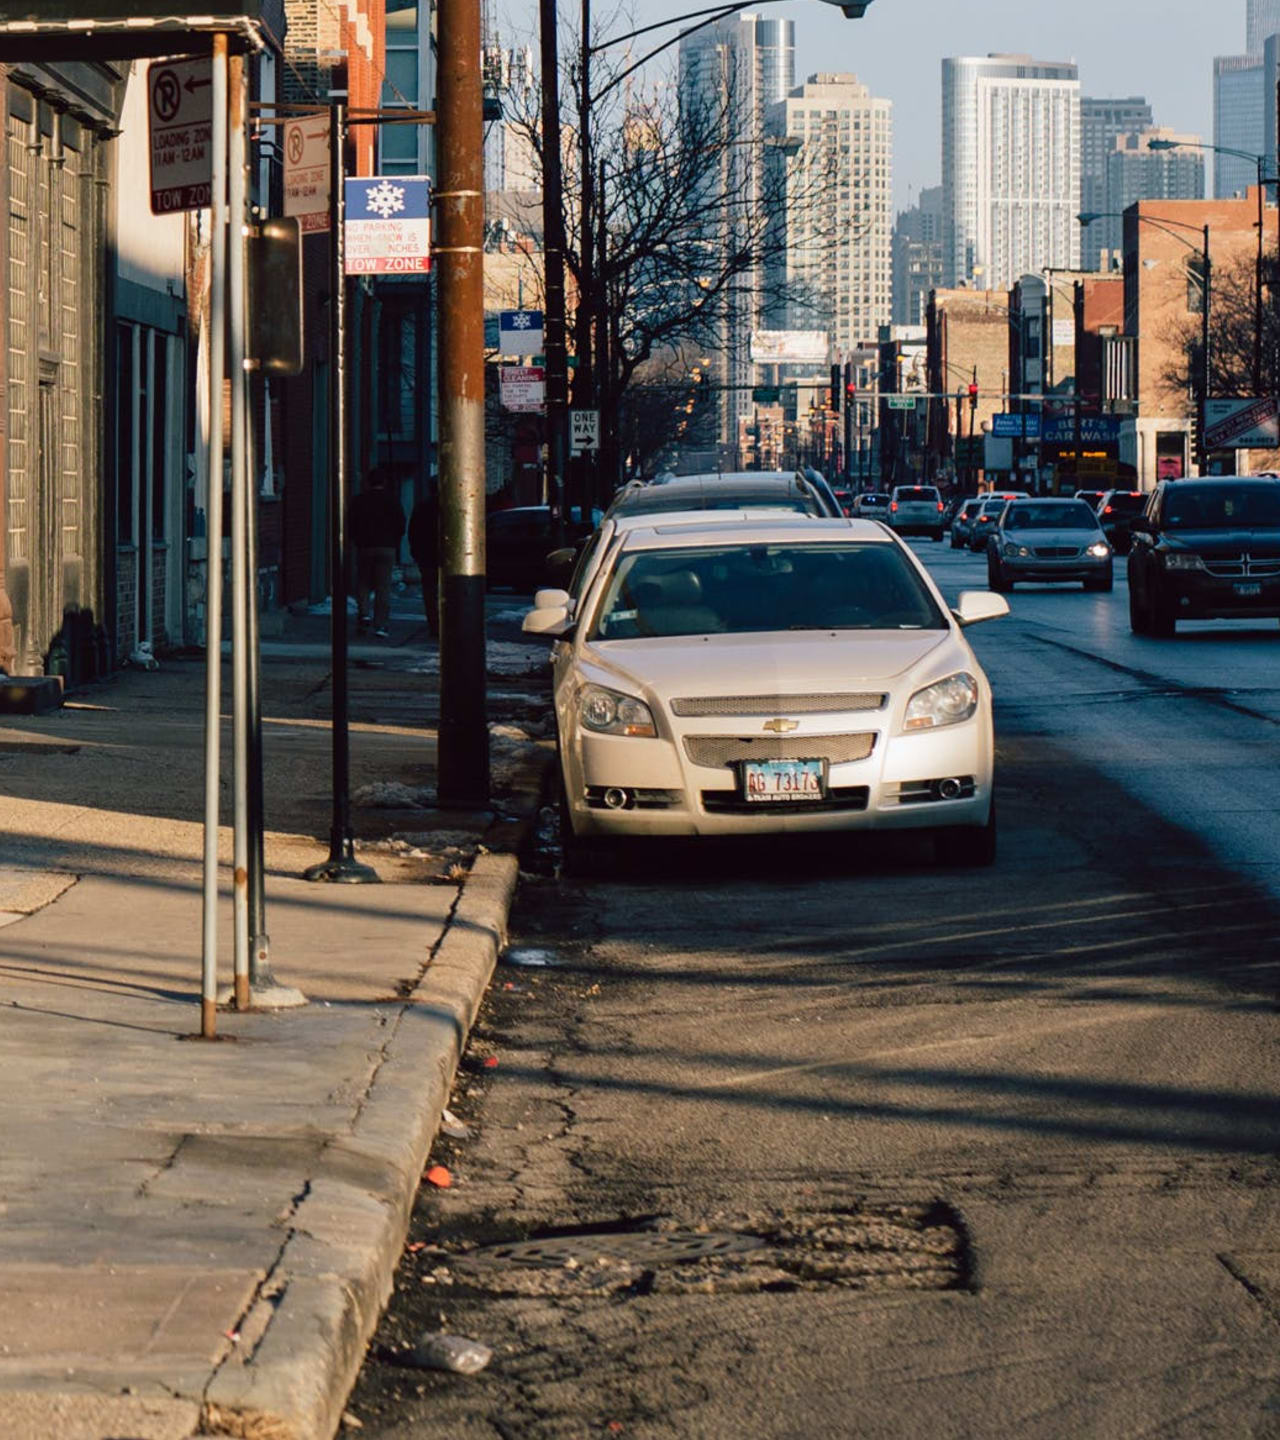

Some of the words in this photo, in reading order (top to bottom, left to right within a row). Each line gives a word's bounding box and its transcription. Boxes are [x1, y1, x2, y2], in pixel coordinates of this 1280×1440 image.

[153, 131, 190, 150] LOADING
[194, 125, 212, 144] ZON
[155, 190, 182, 210] TOW
[190, 184, 211, 205] ZON
[363, 222, 403, 232] PARKING
[345, 258, 377, 271] TOW
[384, 257, 425, 270] ZONE
[574, 412, 595, 422] ONE
[574, 423, 596, 433] WAY
[1045, 431, 1074, 441] CAR
